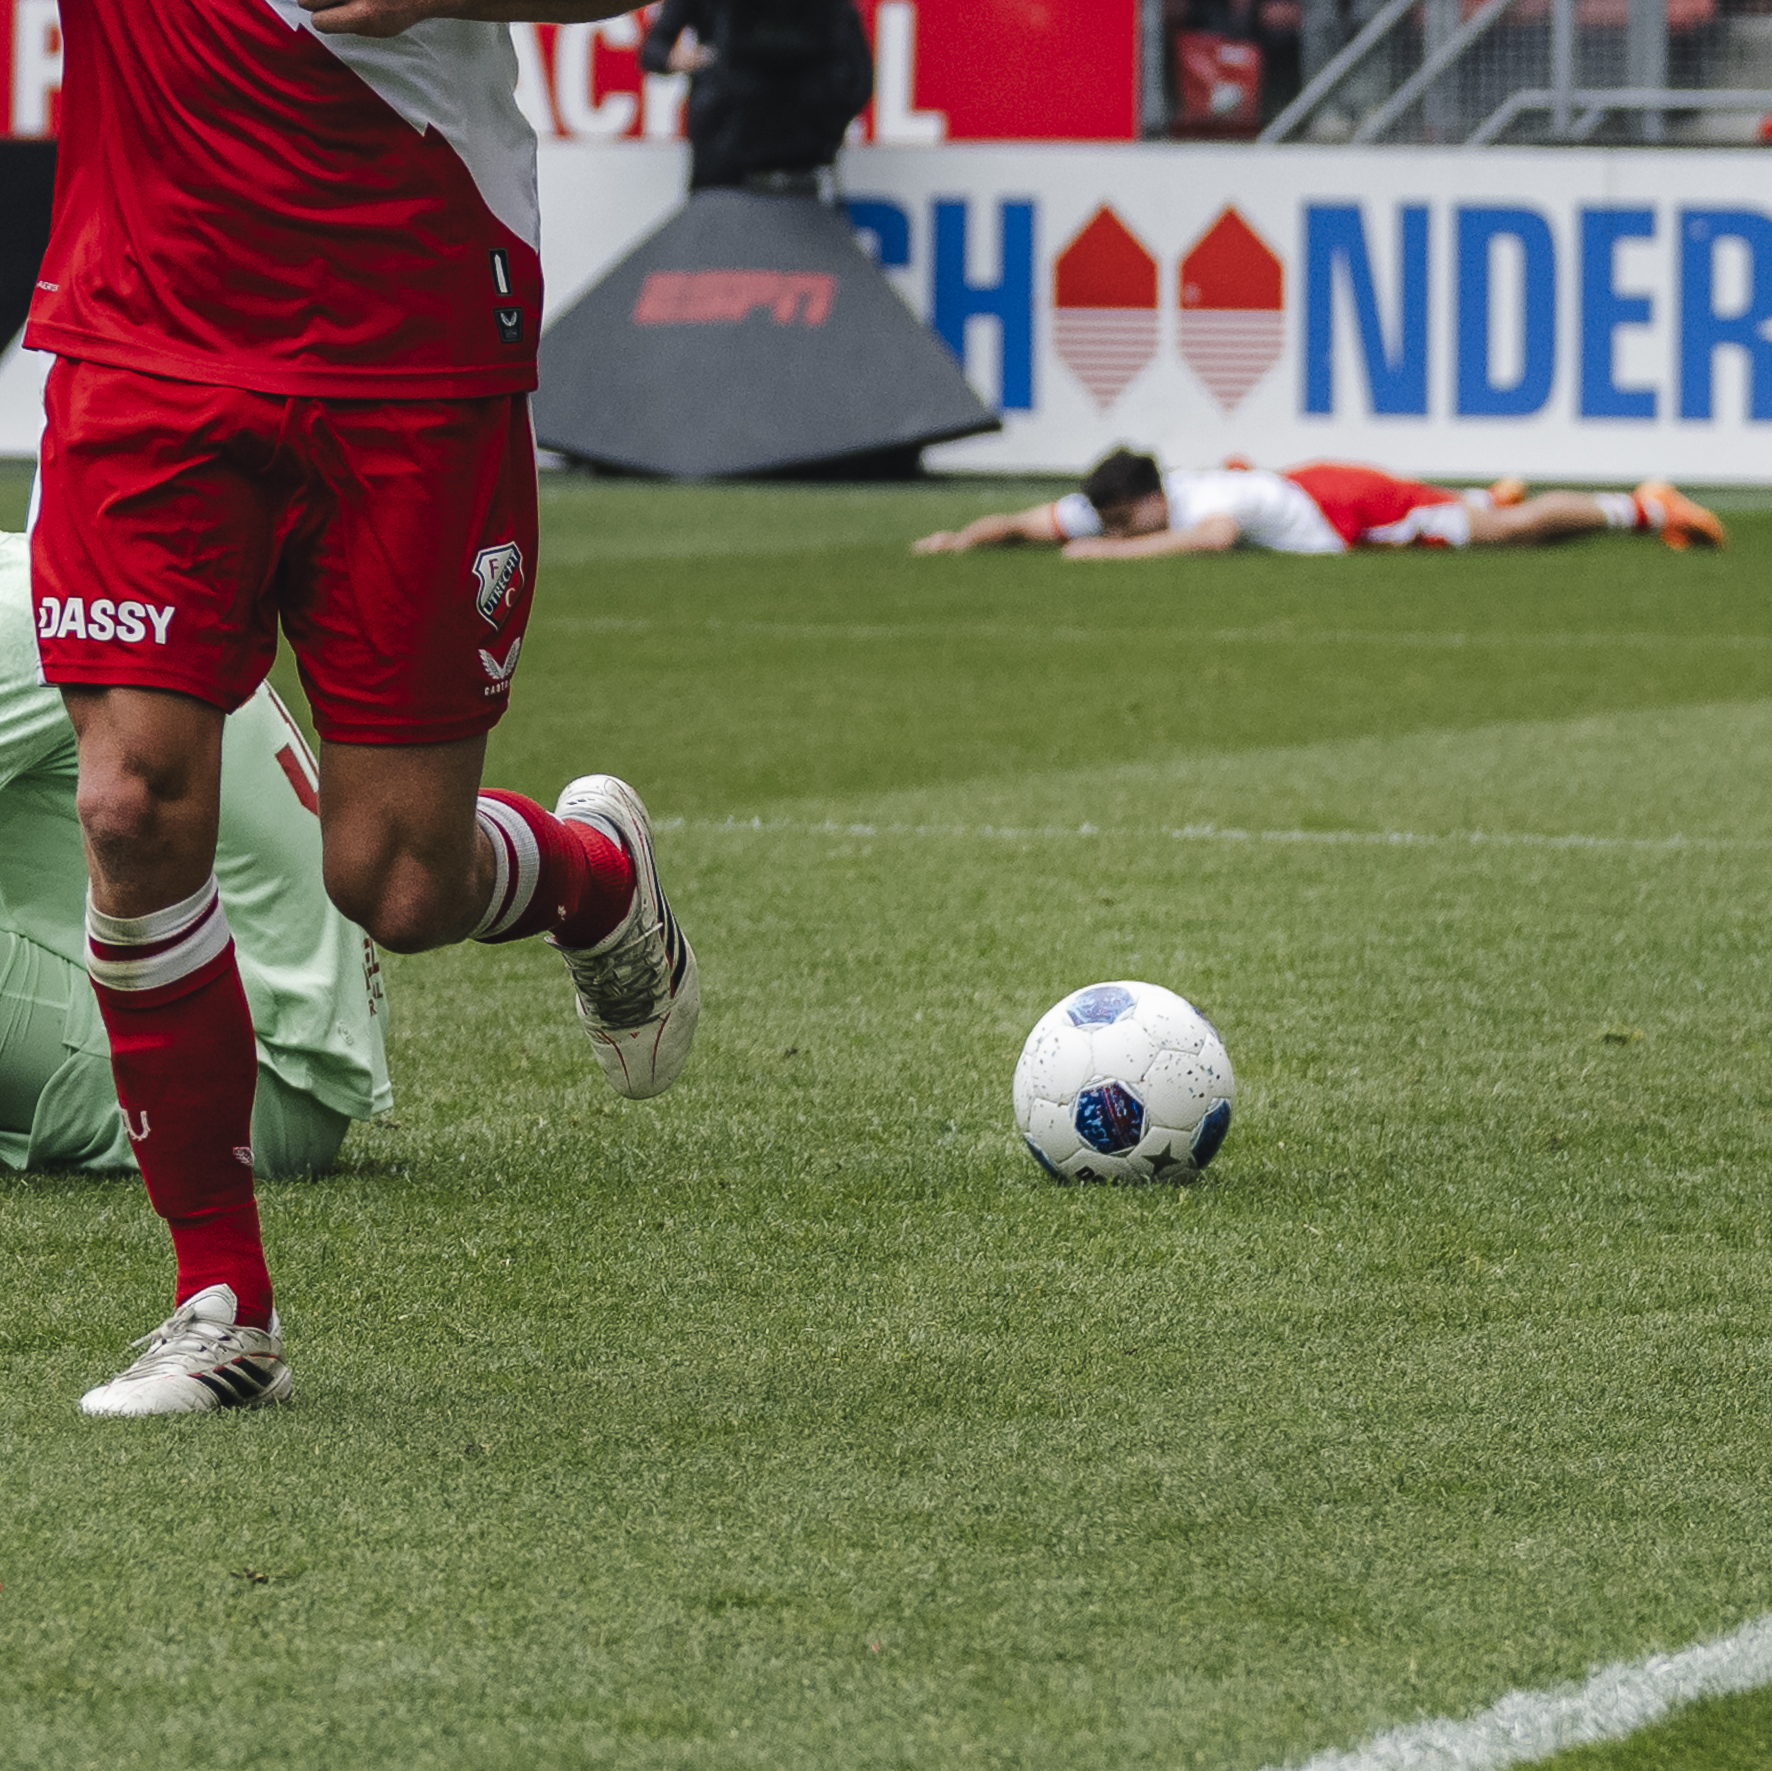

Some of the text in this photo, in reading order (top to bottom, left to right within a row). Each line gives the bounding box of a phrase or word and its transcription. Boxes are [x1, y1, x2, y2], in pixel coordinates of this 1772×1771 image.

[632, 269, 838, 326] ESPN
[482, 549, 520, 616] UTRECHT
[38, 595, 177, 645] DASSY
